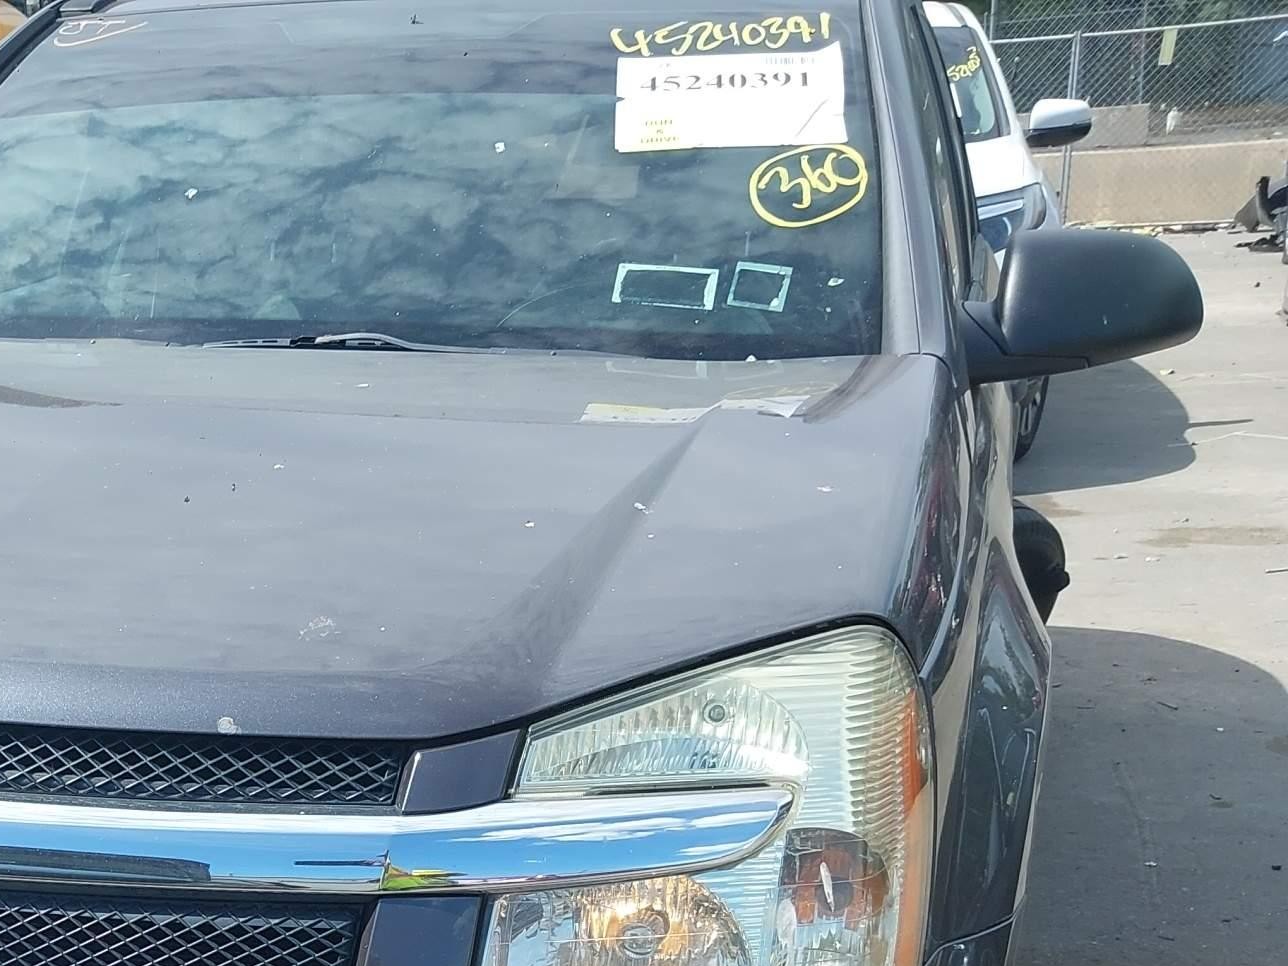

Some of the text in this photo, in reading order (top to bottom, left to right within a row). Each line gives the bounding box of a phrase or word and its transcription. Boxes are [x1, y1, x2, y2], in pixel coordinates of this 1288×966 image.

[610, 12, 831, 56] 45240391
[640, 71, 809, 92] 45240391
[758, 152, 864, 209] 360
